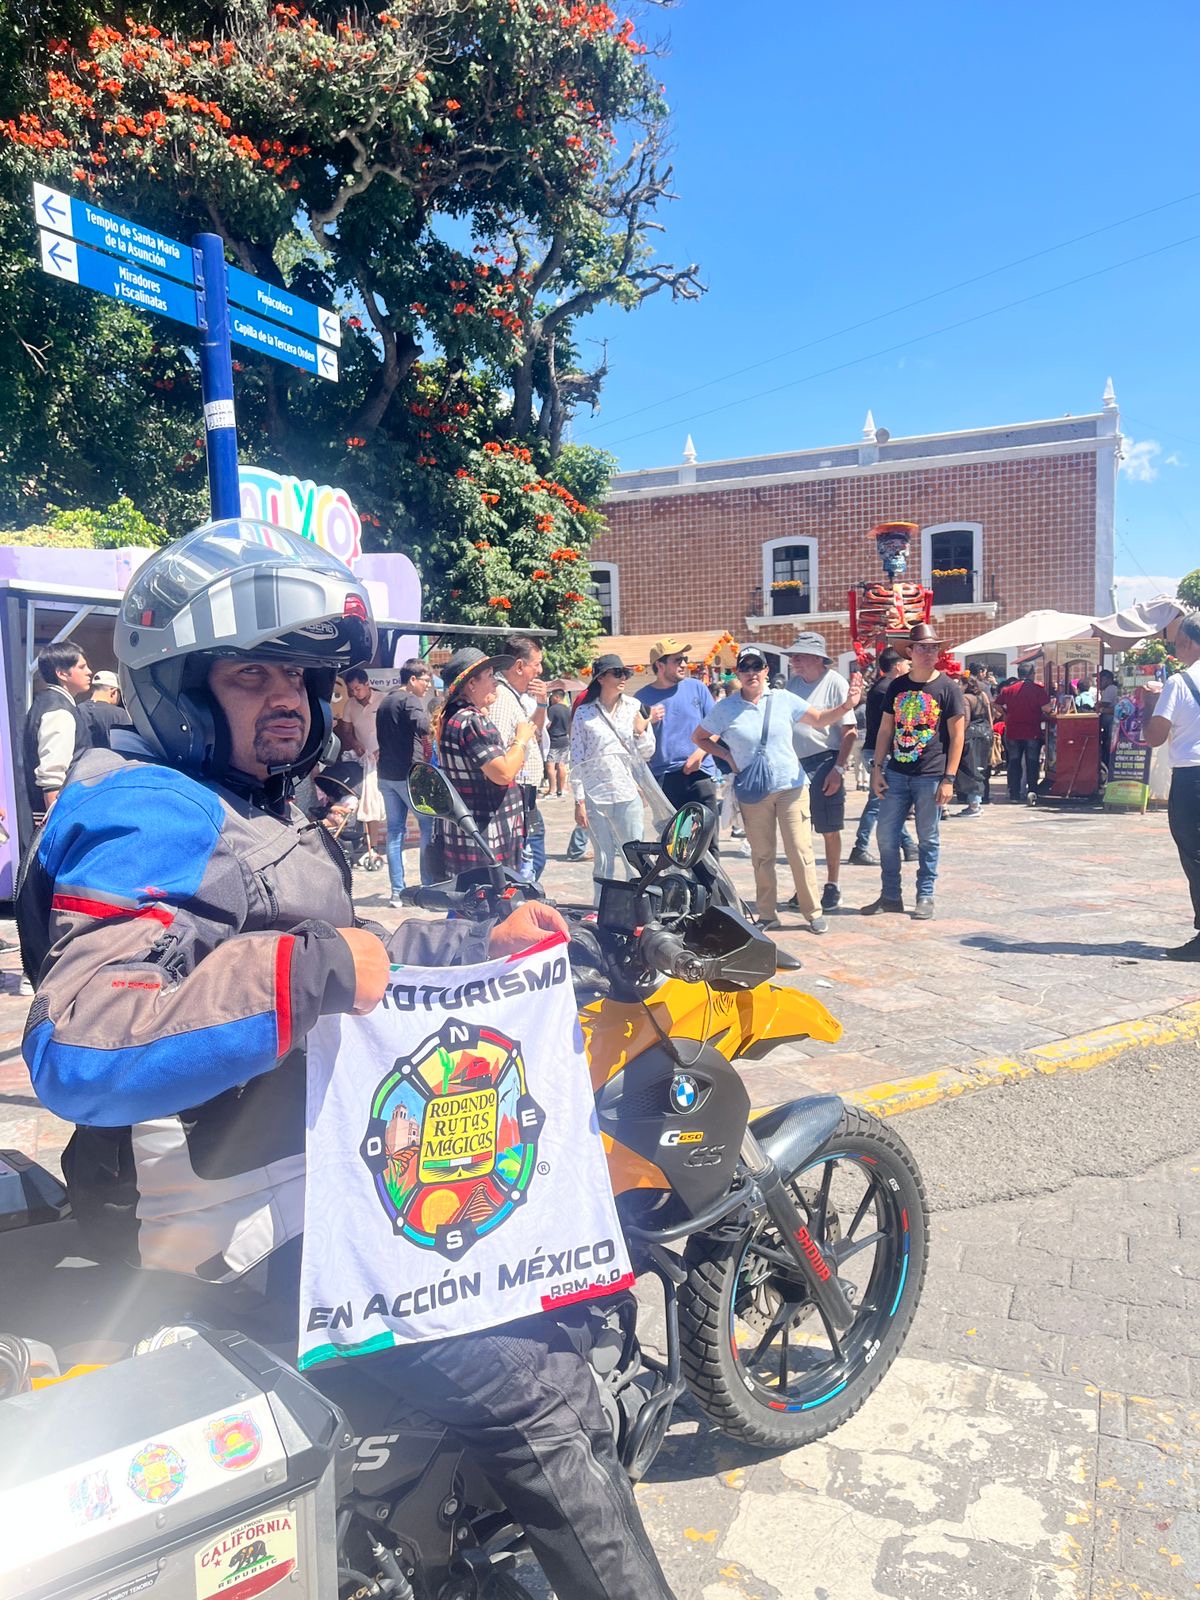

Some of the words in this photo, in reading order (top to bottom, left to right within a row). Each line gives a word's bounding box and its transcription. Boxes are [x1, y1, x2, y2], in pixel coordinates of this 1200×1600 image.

[86, 208, 119, 232] Templo
[120, 224, 131, 238] de
[132, 227, 156, 249] Santa
[157, 238, 180, 259] María
[105, 233, 116, 248] de
[118, 237, 126, 252] la
[127, 242, 166, 268] Asunción
[119, 266, 161, 294] Miradores
[114, 282, 120, 296] y
[121, 283, 168, 311] Escalinatas
[257, 290, 293, 316] Pinacoteca
[234, 320, 257, 339] Capilla
[258, 330, 267, 343] de
[267, 333, 274, 346] la
[274, 336, 296, 355] Tercera
[297, 346, 316, 362] Orden
[382, 957, 568, 1011] TOTURISMO
[449, 1025, 470, 1043] N
[521, 1108, 538, 1127] E
[367, 1136, 382, 1157] O
[888, 1178, 900, 1192] GS
[446, 1230, 464, 1250] S
[793, 1225, 832, 1282] SHOWA
[307, 1301, 353, 1332] EN
[363, 1269, 481, 1320] ACCIÓN
[498, 1239, 615, 1291] MÉXICO
[551, 1278, 588, 1298] RRM
[596, 1268, 620, 1285] 4.0
[351, 1434, 400, 1472] S
[230, 1518, 263, 1535] HOLLYWOOD
[201, 1518, 292, 1568] CALIFORNIA
[129, 1579, 154, 1595] TENORIO
[218, 1558, 277, 1589] REPUBLIC
